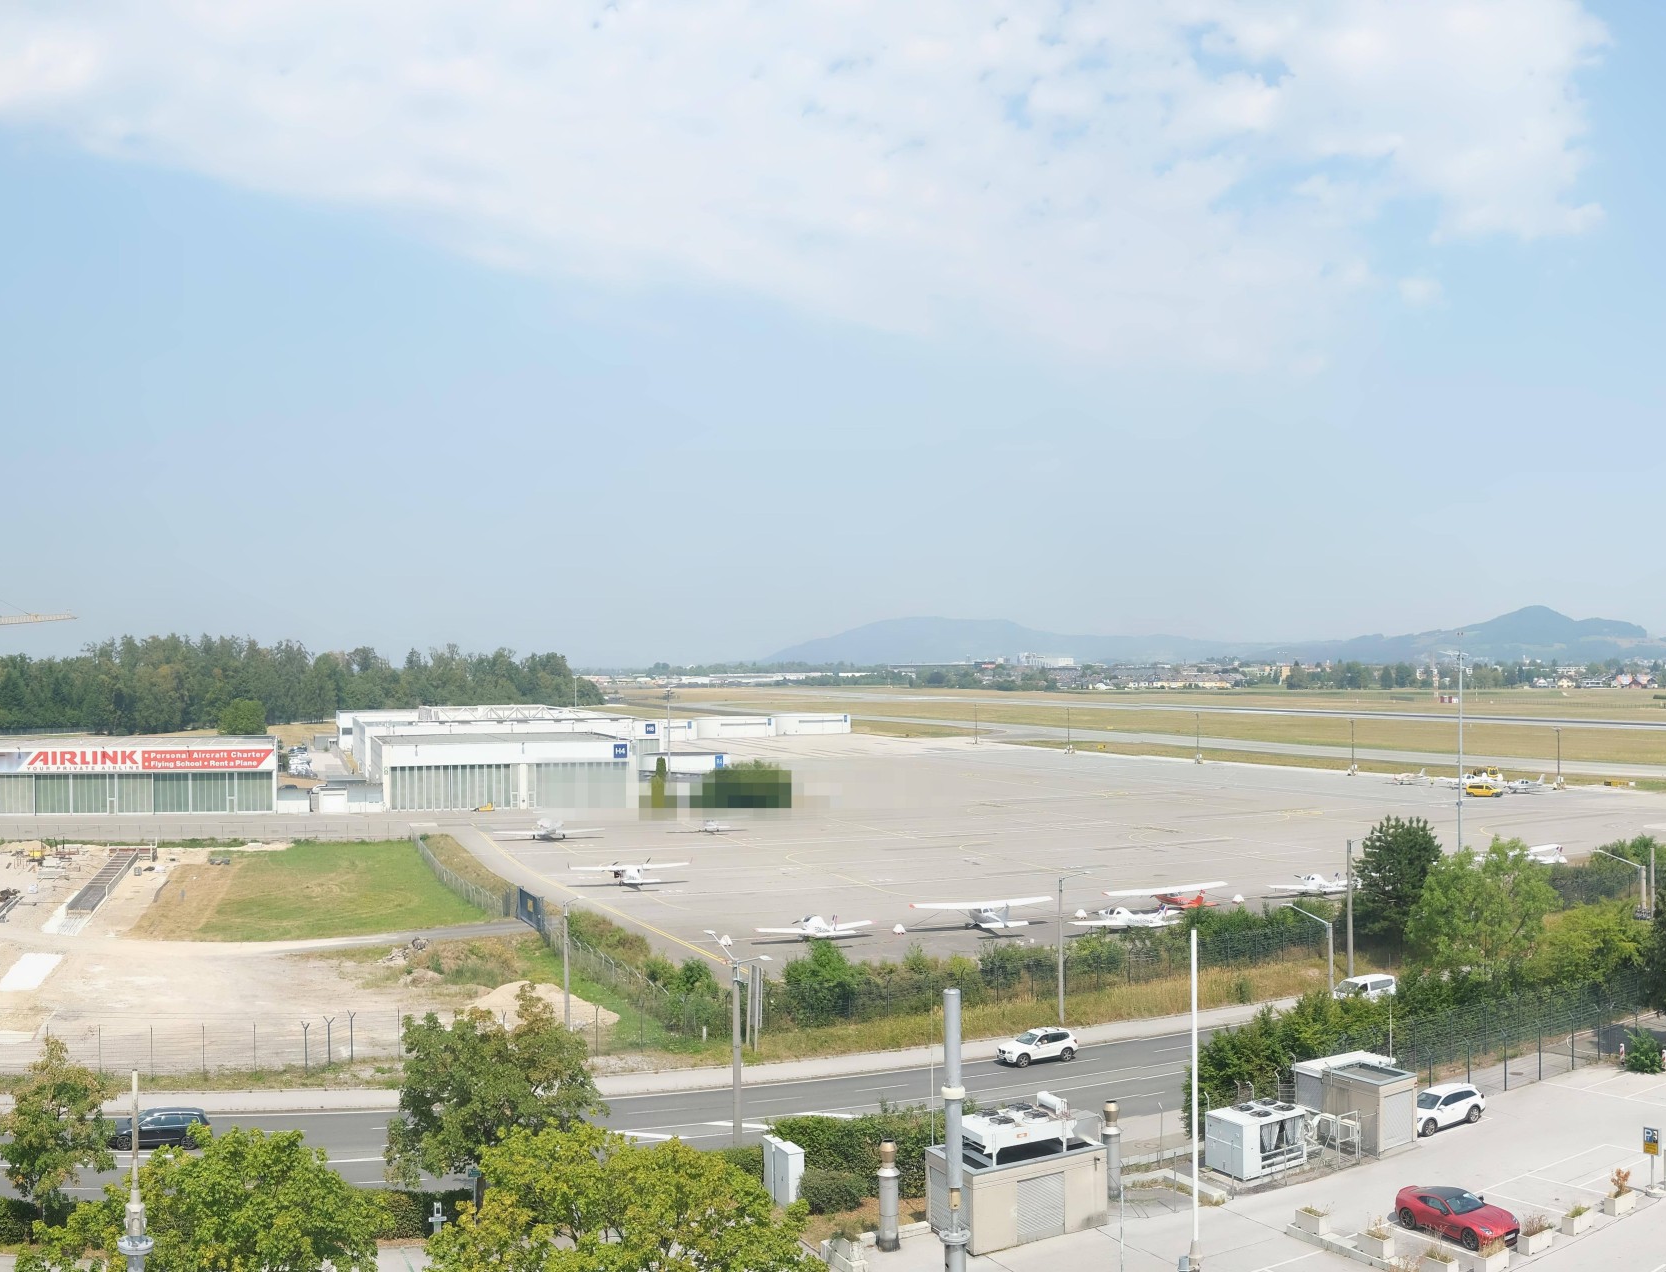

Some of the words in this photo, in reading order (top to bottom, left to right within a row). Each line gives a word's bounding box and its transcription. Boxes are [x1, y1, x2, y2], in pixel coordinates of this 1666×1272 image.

[28, 751, 139, 765] AIRLINK
[193, 751, 228, 759] Aircraft
[150, 760, 174, 768] Flying
